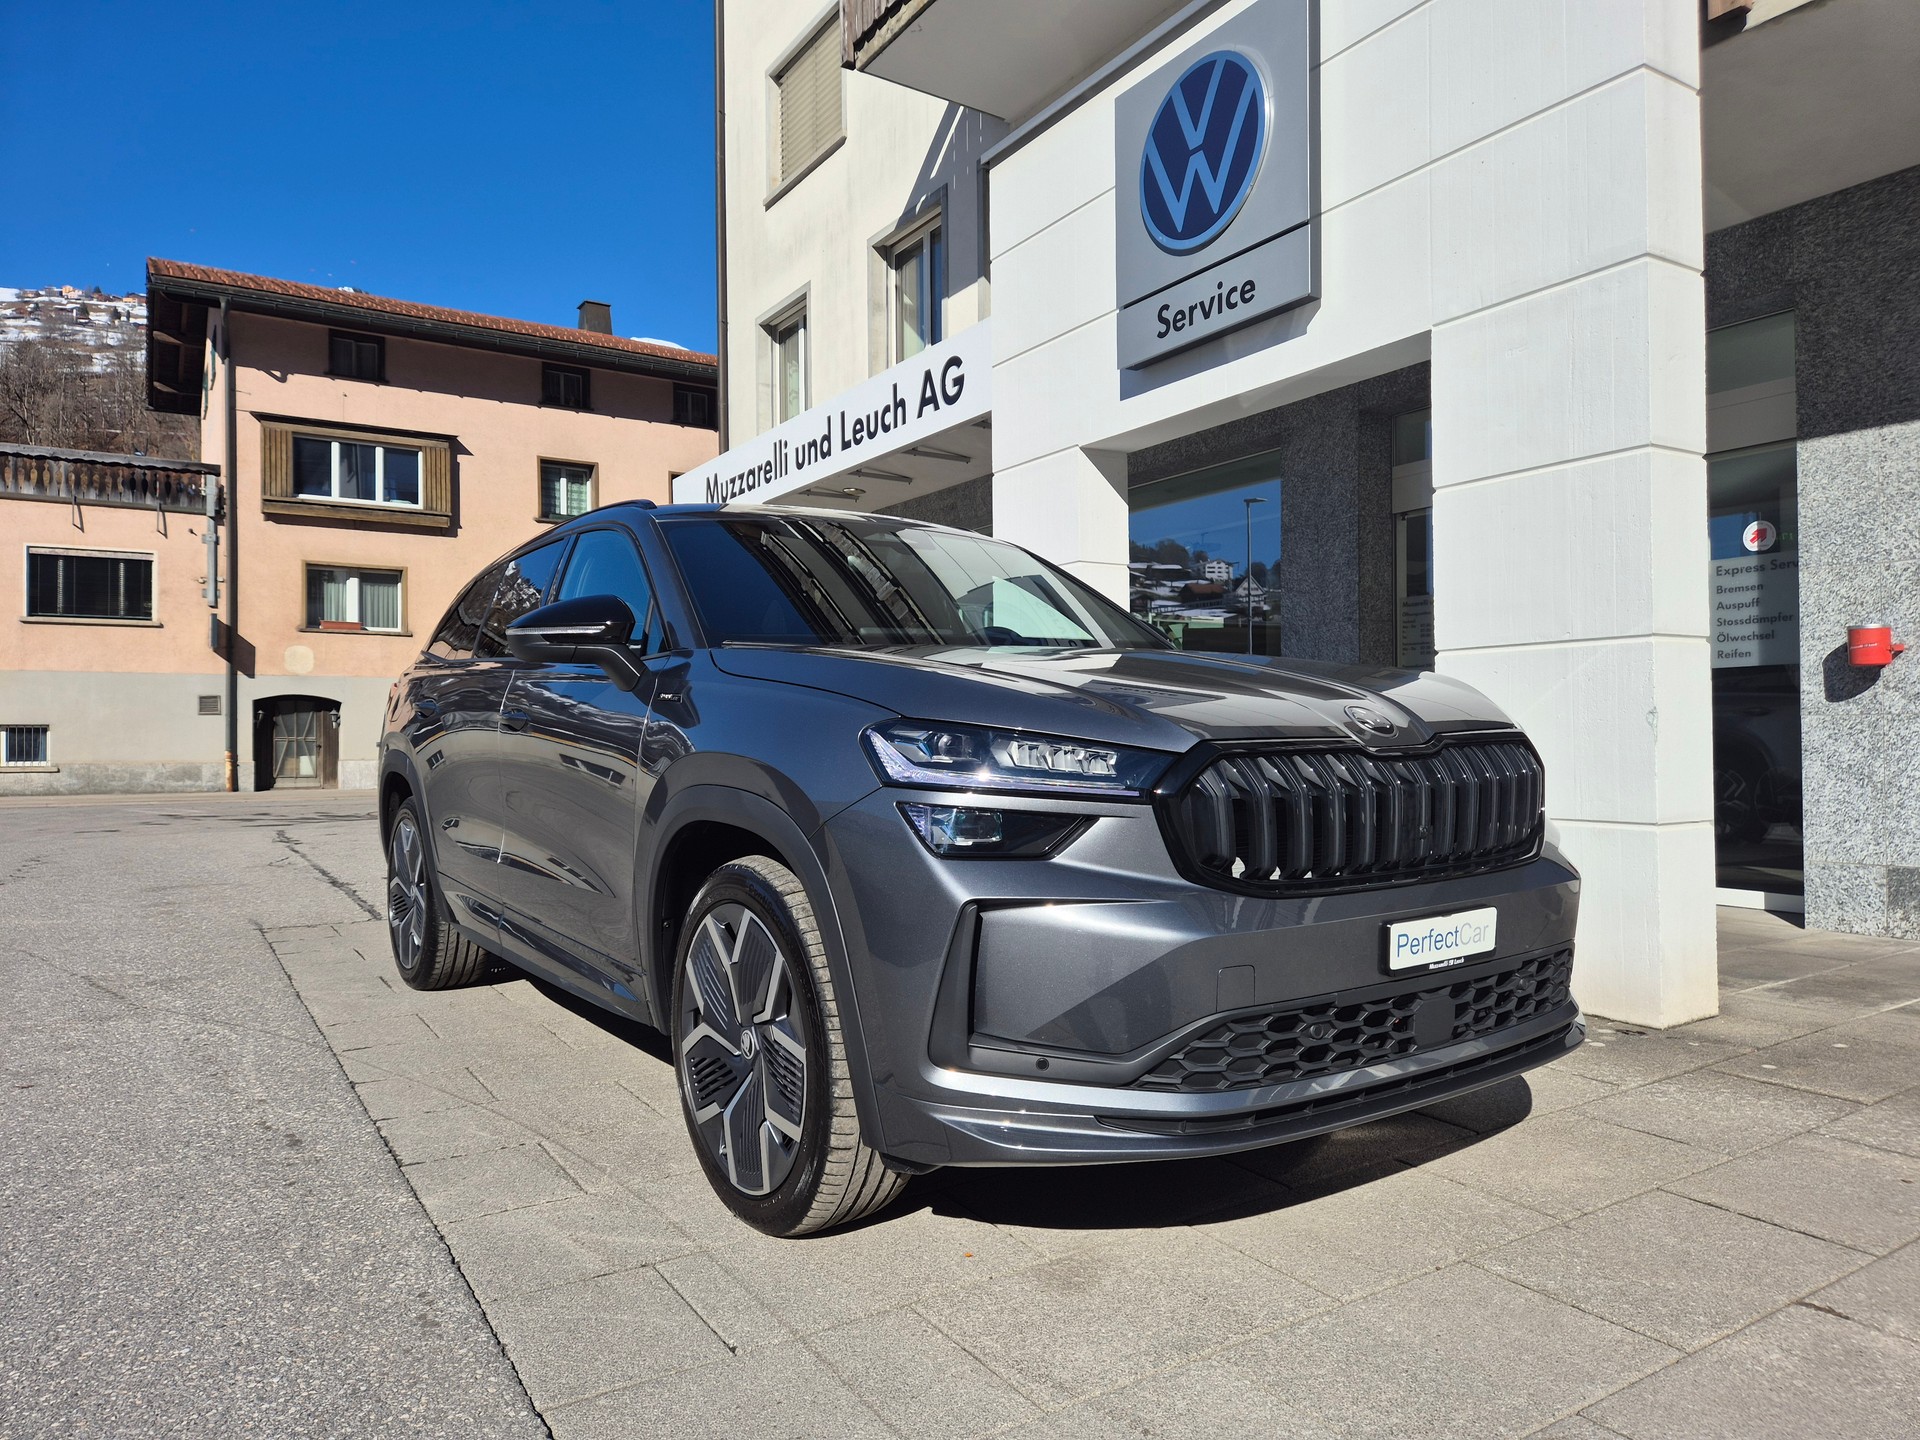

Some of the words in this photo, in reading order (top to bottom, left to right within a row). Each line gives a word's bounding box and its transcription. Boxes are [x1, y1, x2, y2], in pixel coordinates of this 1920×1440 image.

[1157, 278, 1256, 339] Service
[706, 439, 788, 503] Muzzarelli
[795, 415, 832, 471] und
[840, 382, 907, 451] Leuch
[917, 355, 965, 419] AG
[1716, 563, 1765, 577] Express
[1716, 583, 1764, 594] Bremsen
[1716, 597, 1760, 611] Auspuff
[1716, 611, 1794, 627] Stossdämpfer
[1716, 629, 1775, 643] Ölwechsel
[1717, 648, 1751, 659] Reifen
[1397, 922, 1490, 958] PerfectCar
